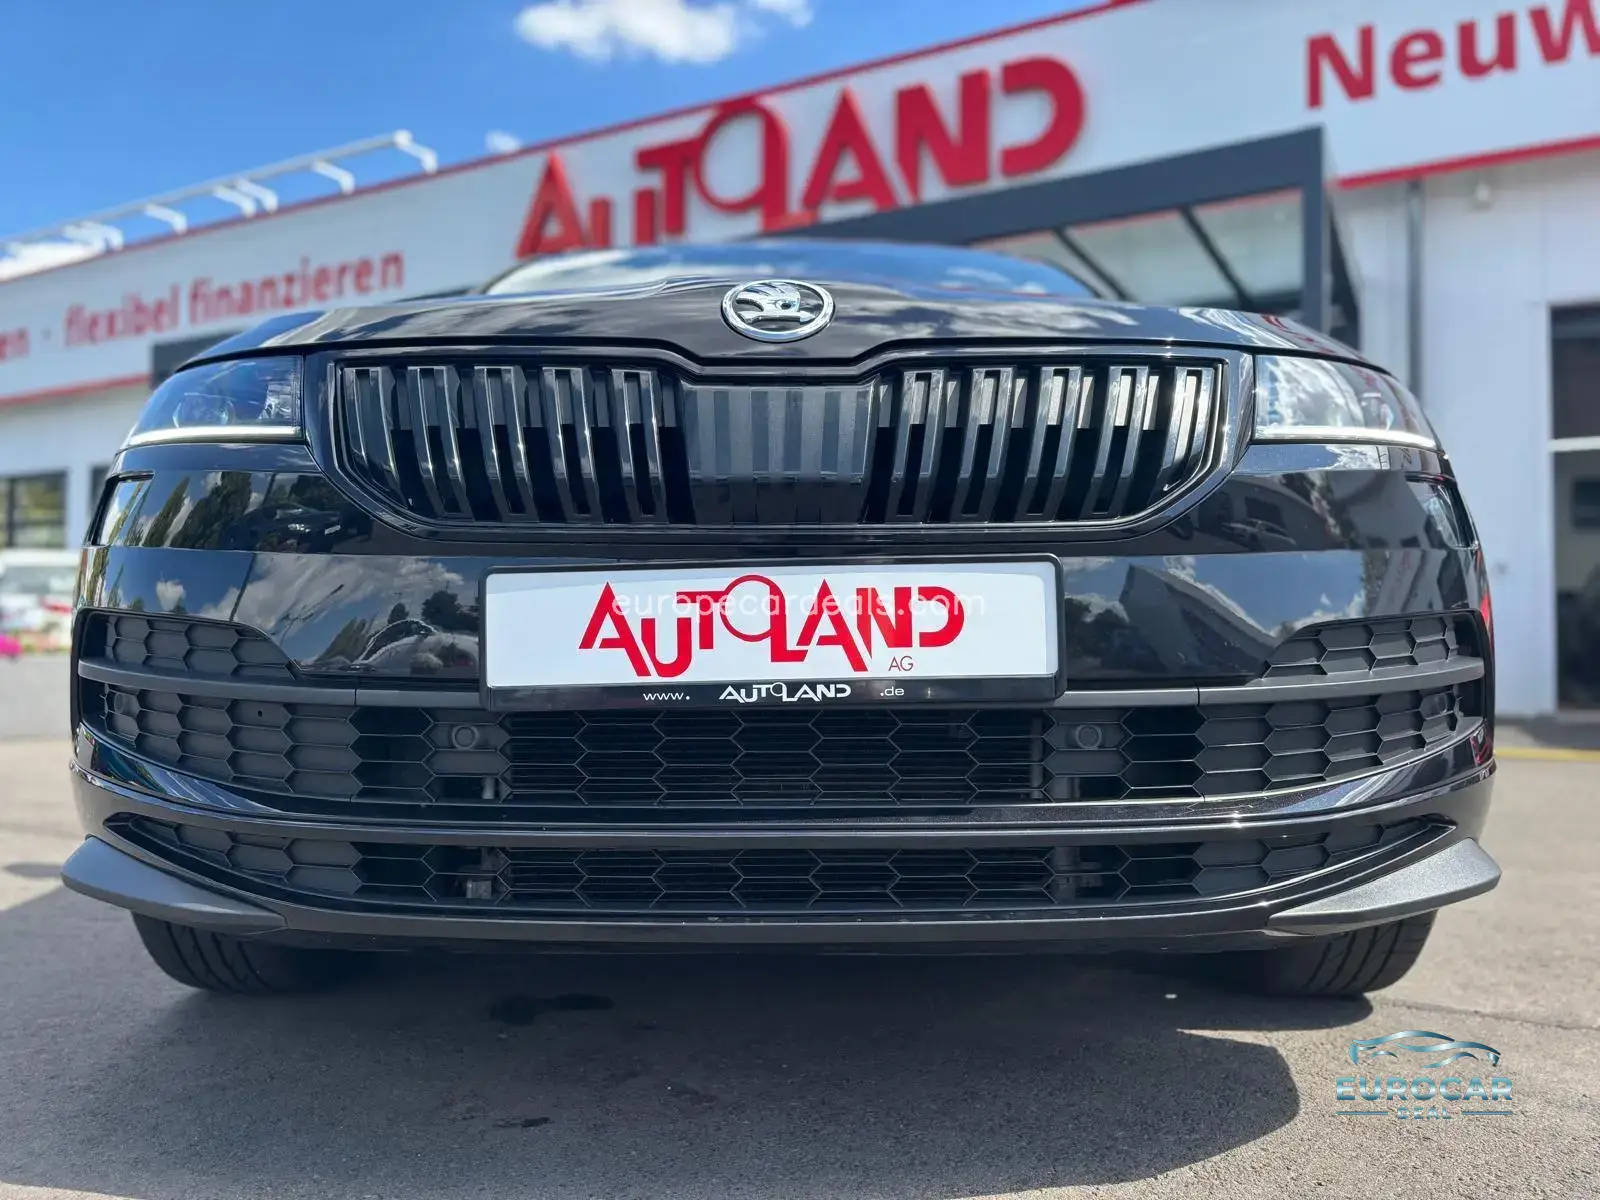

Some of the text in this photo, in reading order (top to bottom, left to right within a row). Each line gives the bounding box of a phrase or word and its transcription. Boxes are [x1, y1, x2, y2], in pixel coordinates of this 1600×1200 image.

[579, 574, 965, 678] AUTOLAND
[888, 655, 915, 672] AG
[642, 681, 905, 704] www. AUTOLAND .de
